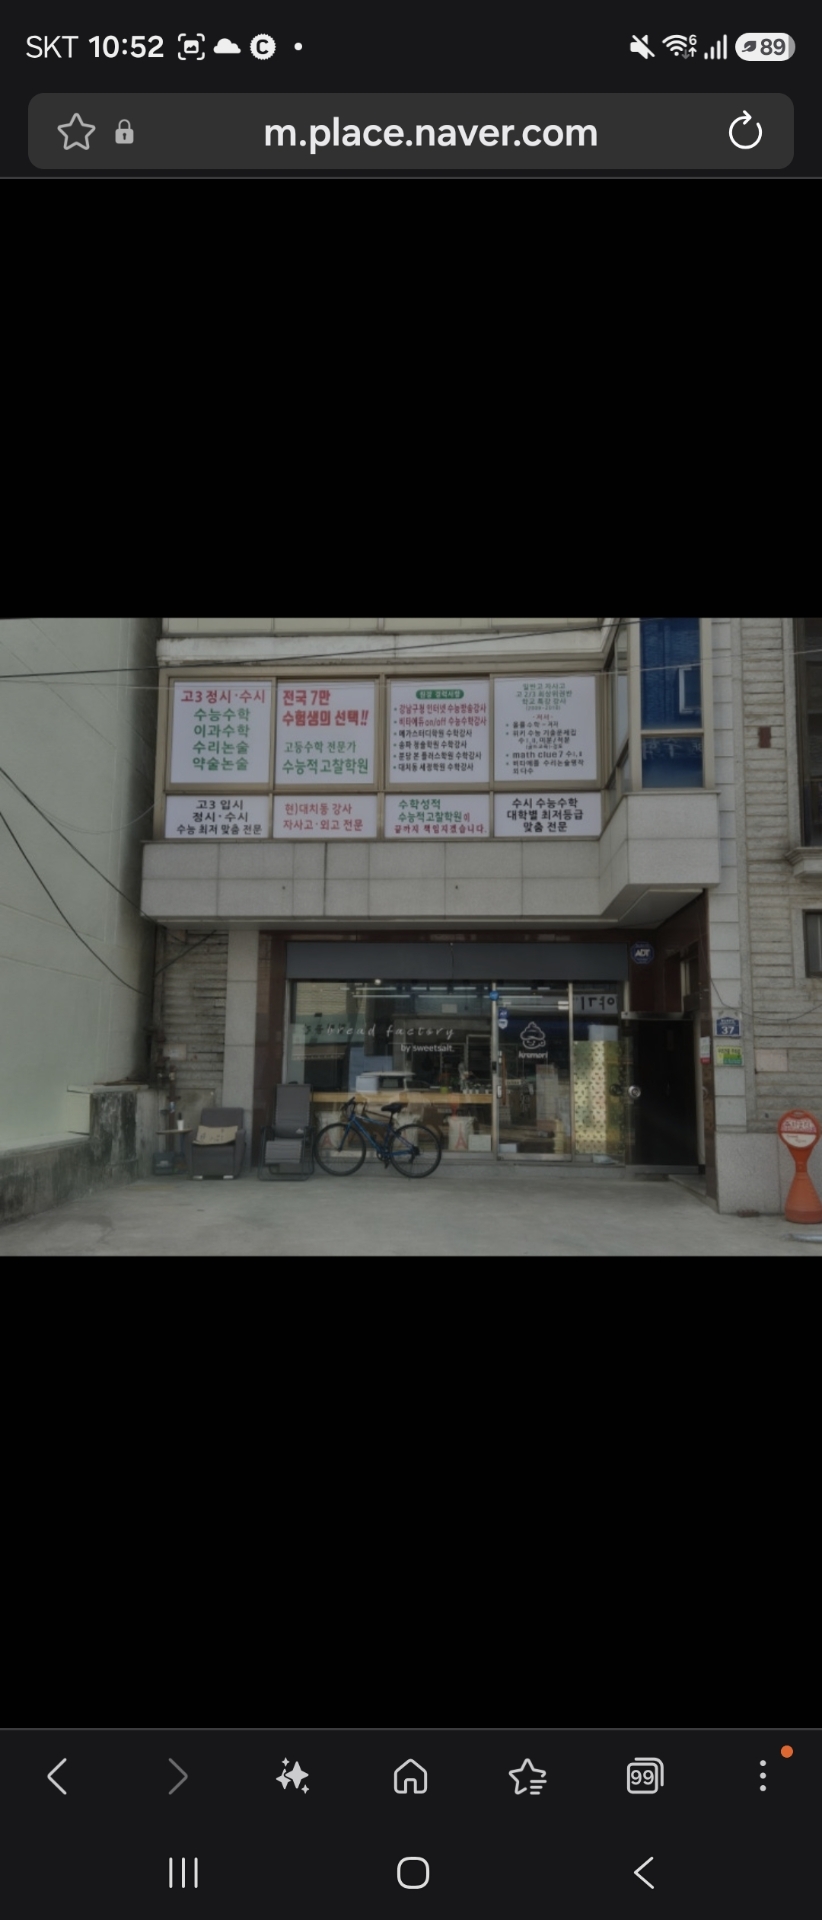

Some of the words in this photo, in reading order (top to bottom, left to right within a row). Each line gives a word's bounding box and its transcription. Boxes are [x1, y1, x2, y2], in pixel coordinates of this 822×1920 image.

[26, 36, 78, 60] SKT
[89, 35, 164, 60] 10:52
[760, 38, 785, 56] 89
[265, 118, 598, 153] m.place.naver.com
[181, 691, 202, 703] 고3
[283, 690, 307, 706] 전국
[311, 690, 330, 705] 7만
[194, 708, 250, 722] 수능수학
[399, 704, 425, 714] 강남구청
[427, 704, 446, 713] 인터넷
[448, 704, 486, 713] 수능방송강사
[282, 710, 331, 727] 수험생의
[335, 710, 369, 726] 선택!!
[449, 717, 487, 726] 수능수학강사
[194, 725, 250, 738] 이과수학
[399, 730, 444, 738] 메가스터디학원
[446, 729, 472, 737] 수학강사
[193, 741, 249, 754] 수리논술
[285, 741, 323, 754] 고등수학
[327, 741, 356, 753] 전문가
[441, 740, 467, 749] 수학강사
[399, 752, 411, 761] 분당
[456, 752, 481, 760] 수학강사
[193, 757, 248, 771] 약술논술
[282, 758, 368, 774] 수능적고찰학원
[398, 763, 417, 771] 대치동
[447, 763, 474, 771] 수학강사
[196, 801, 215, 810] 고3
[221, 800, 243, 810] 입시
[285, 803, 328, 815] 현)대치동
[332, 803, 352, 815] 강사
[399, 799, 441, 810] 수학성적
[512, 798, 532, 808] 수시
[536, 798, 578, 808] 수능수학
[507, 810, 538, 820] 대학별
[541, 810, 583, 820] 최저등급
[177, 824, 196, 834] 수능
[199, 824, 218, 834] 최저
[221, 824, 239, 835] 맞춤
[243, 824, 262, 834] 전문
[344, 819, 363, 831] 전문
[394, 824, 419, 834] 끝까지
[523, 822, 543, 832] 맞춤
[547, 822, 567, 832] 전문
[635, 949, 650, 957] ADT
[327, 1024, 375, 1036] bread
[386, 1025, 454, 1039] factory
[631, 1770, 654, 1785] 99
